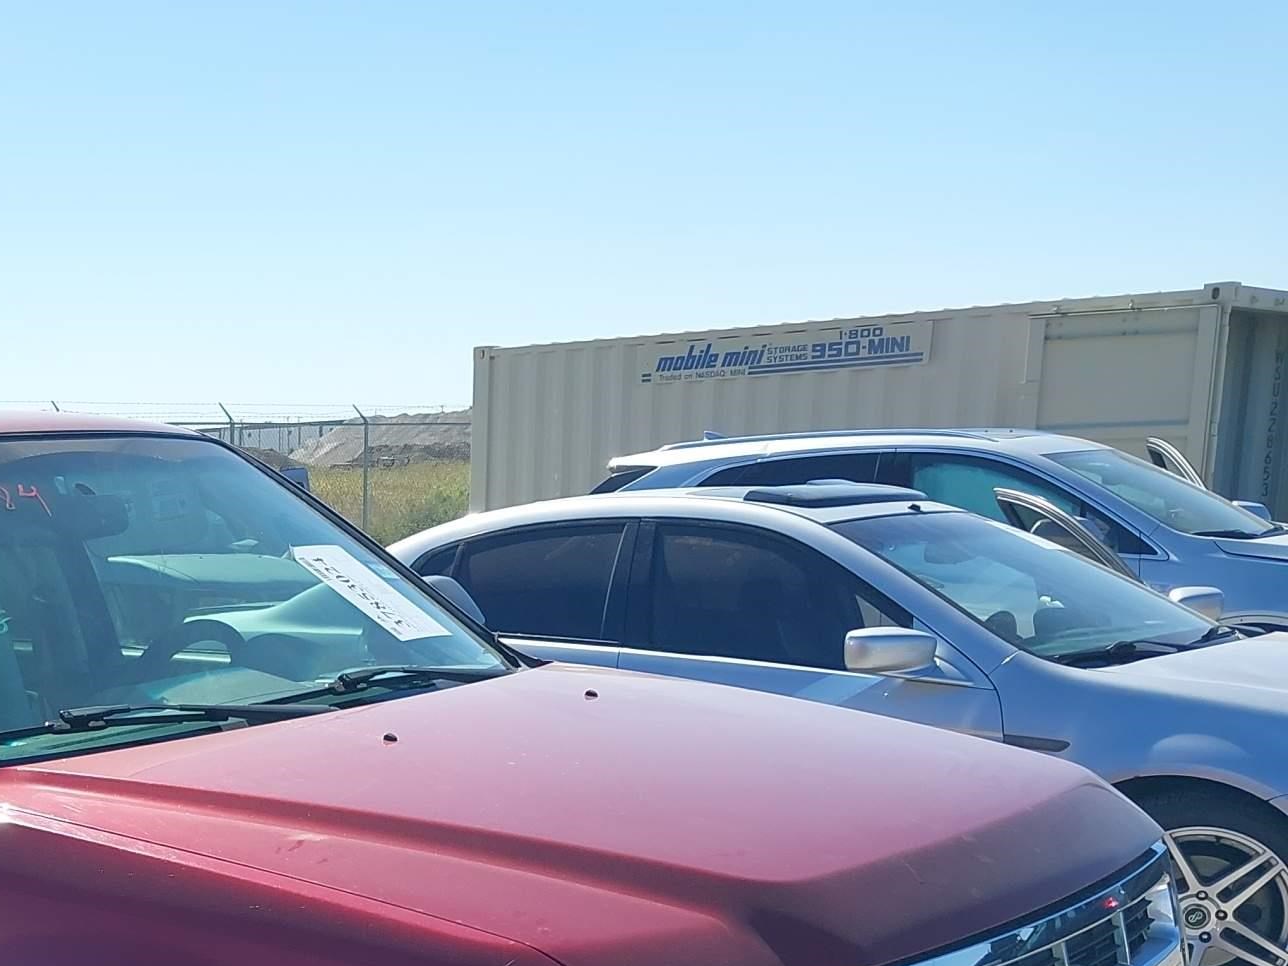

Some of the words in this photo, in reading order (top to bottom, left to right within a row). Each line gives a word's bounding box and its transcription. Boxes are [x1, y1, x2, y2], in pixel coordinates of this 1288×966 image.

[767, 344, 809, 356] STORAGE
[656, 343, 719, 372] mobile
[721, 344, 767, 367] mini
[767, 352, 809, 363] SYSTEMS
